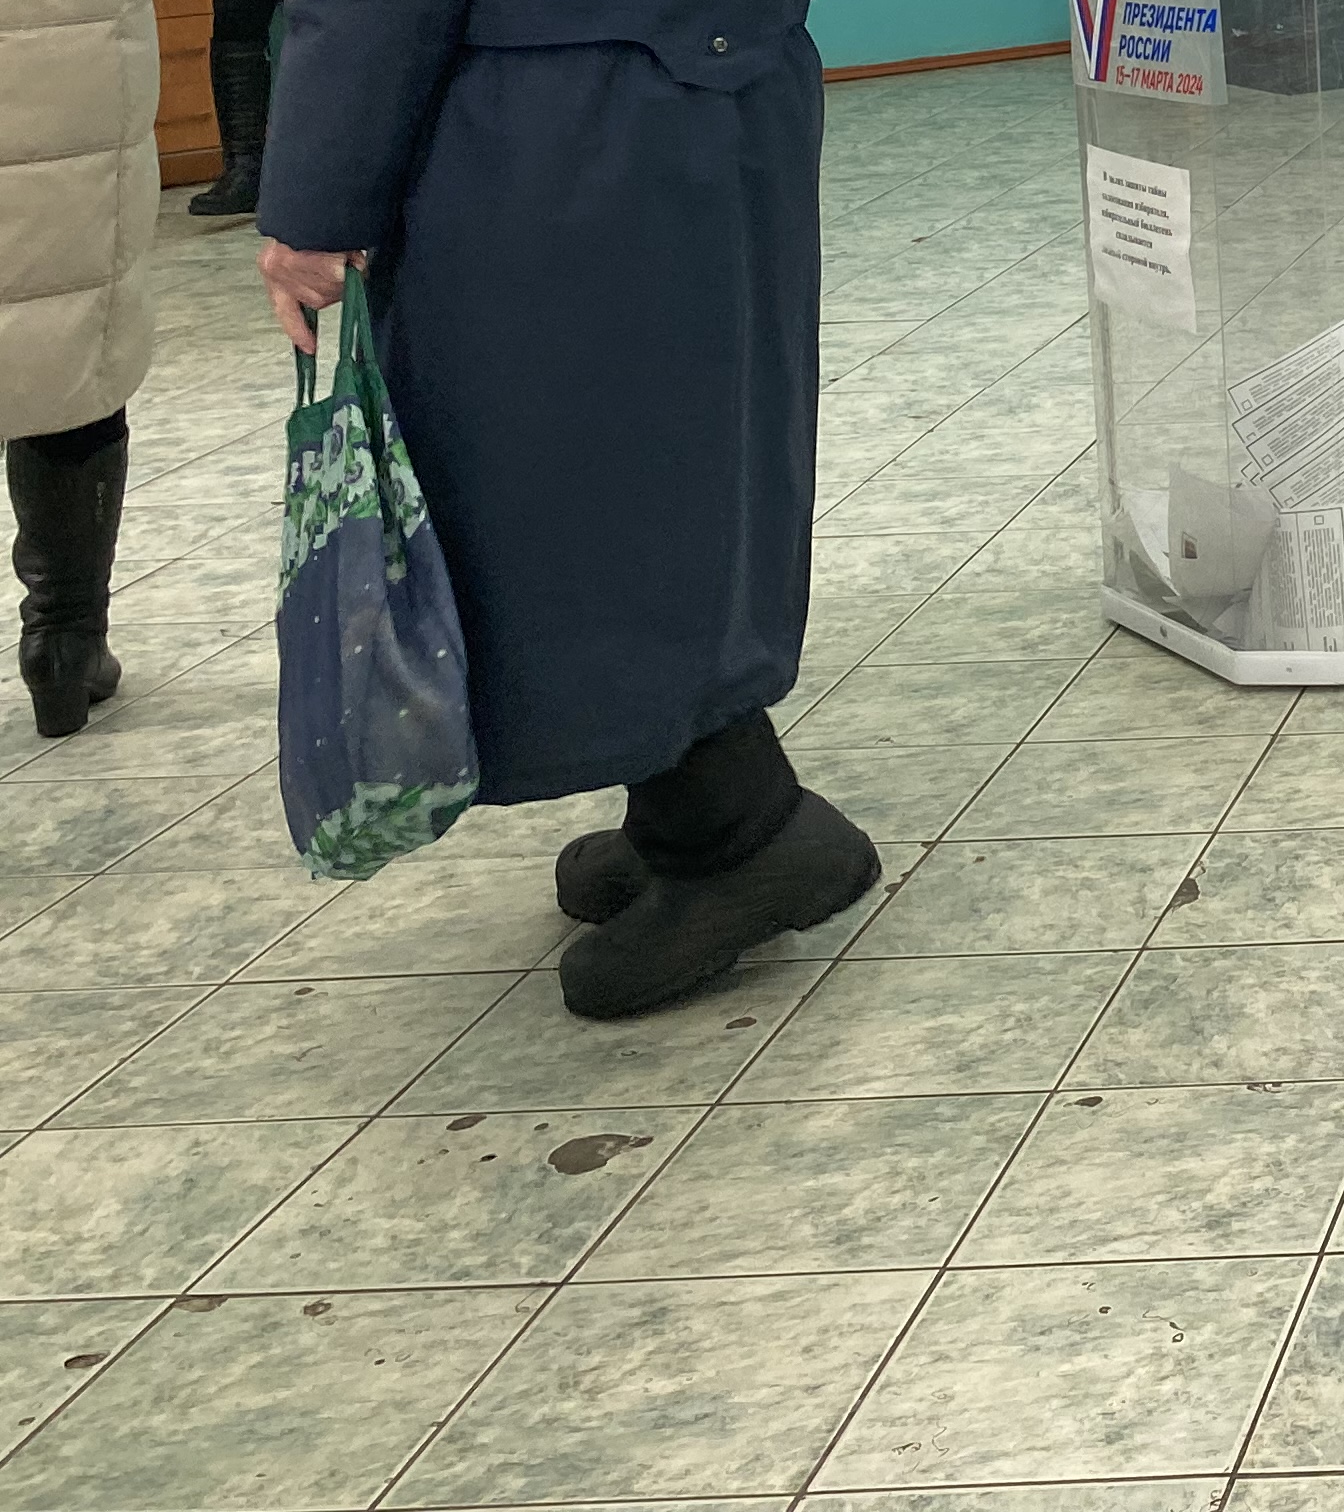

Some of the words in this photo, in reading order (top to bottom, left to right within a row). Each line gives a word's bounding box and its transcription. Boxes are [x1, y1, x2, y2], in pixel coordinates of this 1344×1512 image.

[1122, 2, 1218, 34] ПРЕЗИДЕНТА
[1118, 34, 1172, 63] РОССИИ
[1140, 68, 1174, 93] МАРТА
[1175, 73, 1203, 96] 2024
